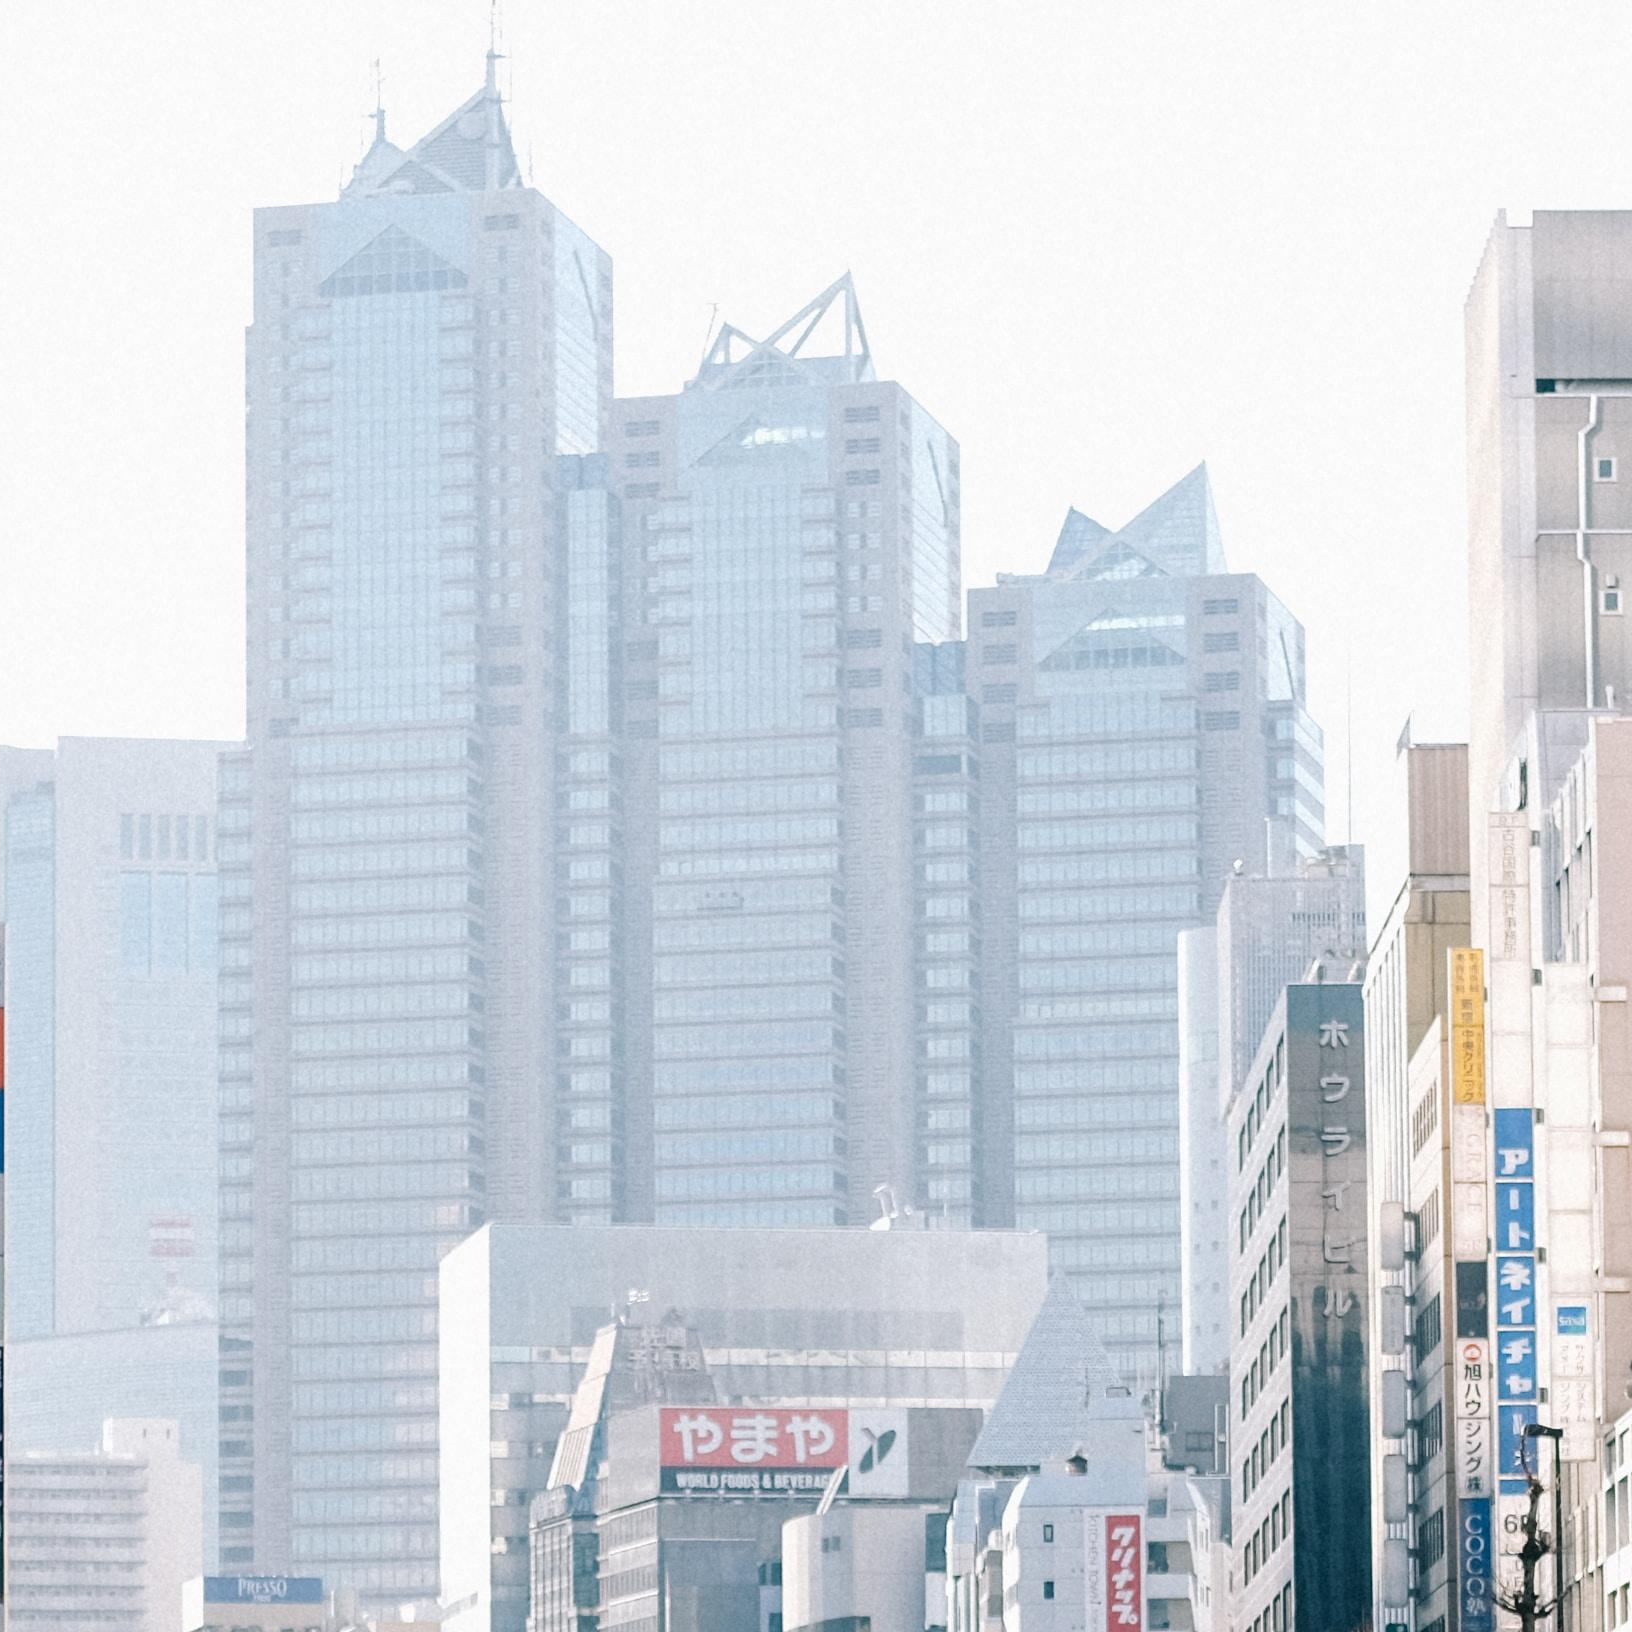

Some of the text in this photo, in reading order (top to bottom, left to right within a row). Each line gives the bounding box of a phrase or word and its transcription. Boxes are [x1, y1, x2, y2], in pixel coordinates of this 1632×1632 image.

[1319, 1020, 1351, 1318] ホウライビル
[674, 1413, 836, 1463] やまや
[675, 1472, 719, 1489] WORLD
[720, 1472, 760, 1489] FOODS
[1111, 1525, 1139, 1626] クリナップ
